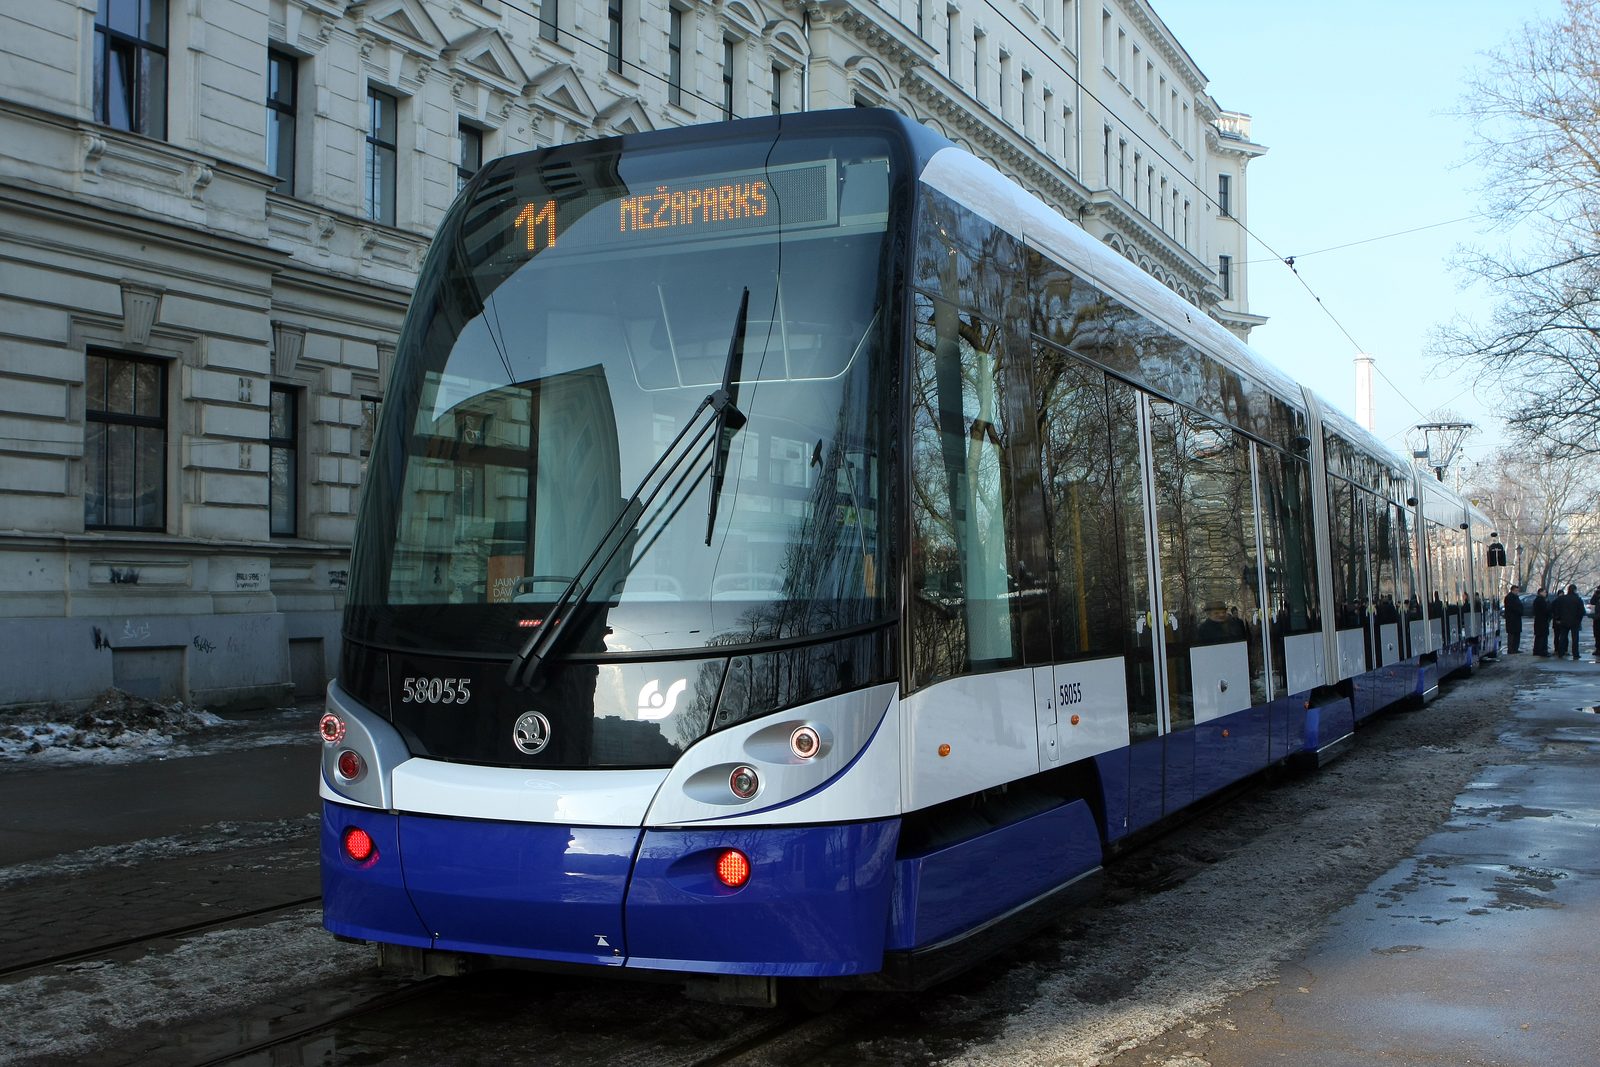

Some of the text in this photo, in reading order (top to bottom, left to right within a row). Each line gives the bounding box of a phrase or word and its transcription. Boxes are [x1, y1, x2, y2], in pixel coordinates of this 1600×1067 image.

[514, 181, 767, 250] 11 MEŽAPARKS
[402, 677, 471, 705] 58055
[1060, 682, 1082, 706] 58055
